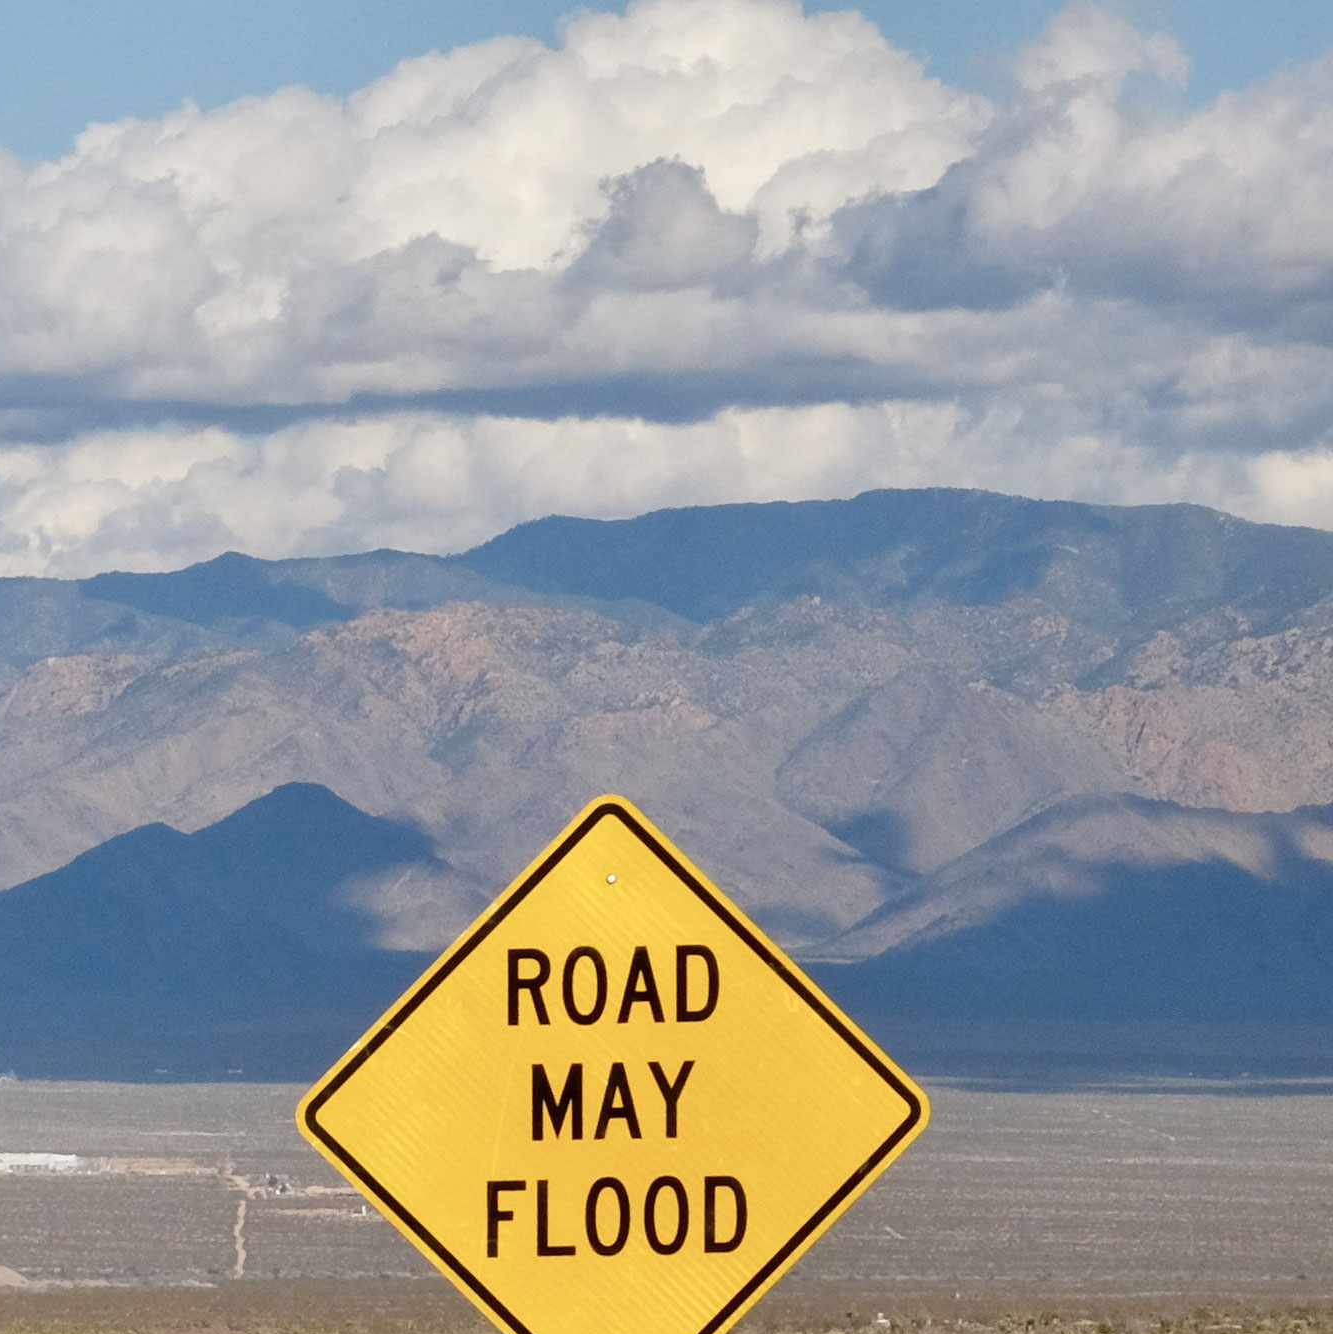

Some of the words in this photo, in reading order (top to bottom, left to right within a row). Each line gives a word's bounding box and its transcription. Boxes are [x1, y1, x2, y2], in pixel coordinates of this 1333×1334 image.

[507, 945, 720, 1026] ROAD
[531, 1060, 695, 1141] MAY
[486, 1175, 747, 1258] FLOOD
